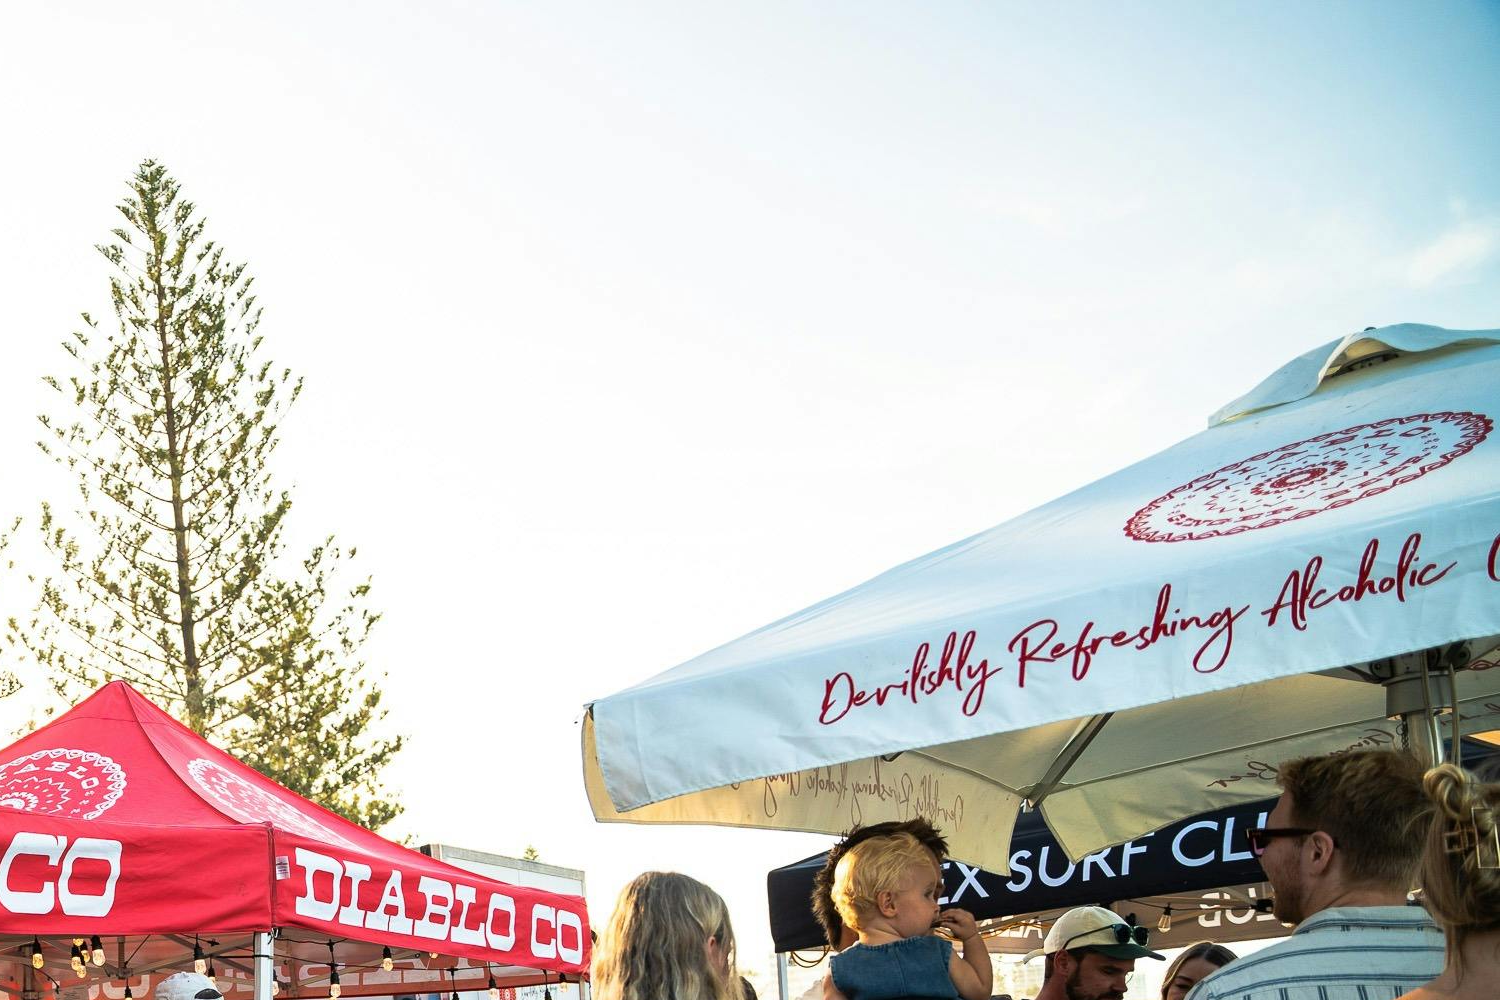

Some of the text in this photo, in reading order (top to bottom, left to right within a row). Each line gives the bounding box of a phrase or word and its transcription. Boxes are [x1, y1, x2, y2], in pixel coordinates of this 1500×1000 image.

[819, 630, 1003, 725] Devilishly
[1009, 583, 1250, 673] Refreshing
[1261, 533, 1457, 631] Alcoholic
[295, 847, 583, 965] DIABLO CO
